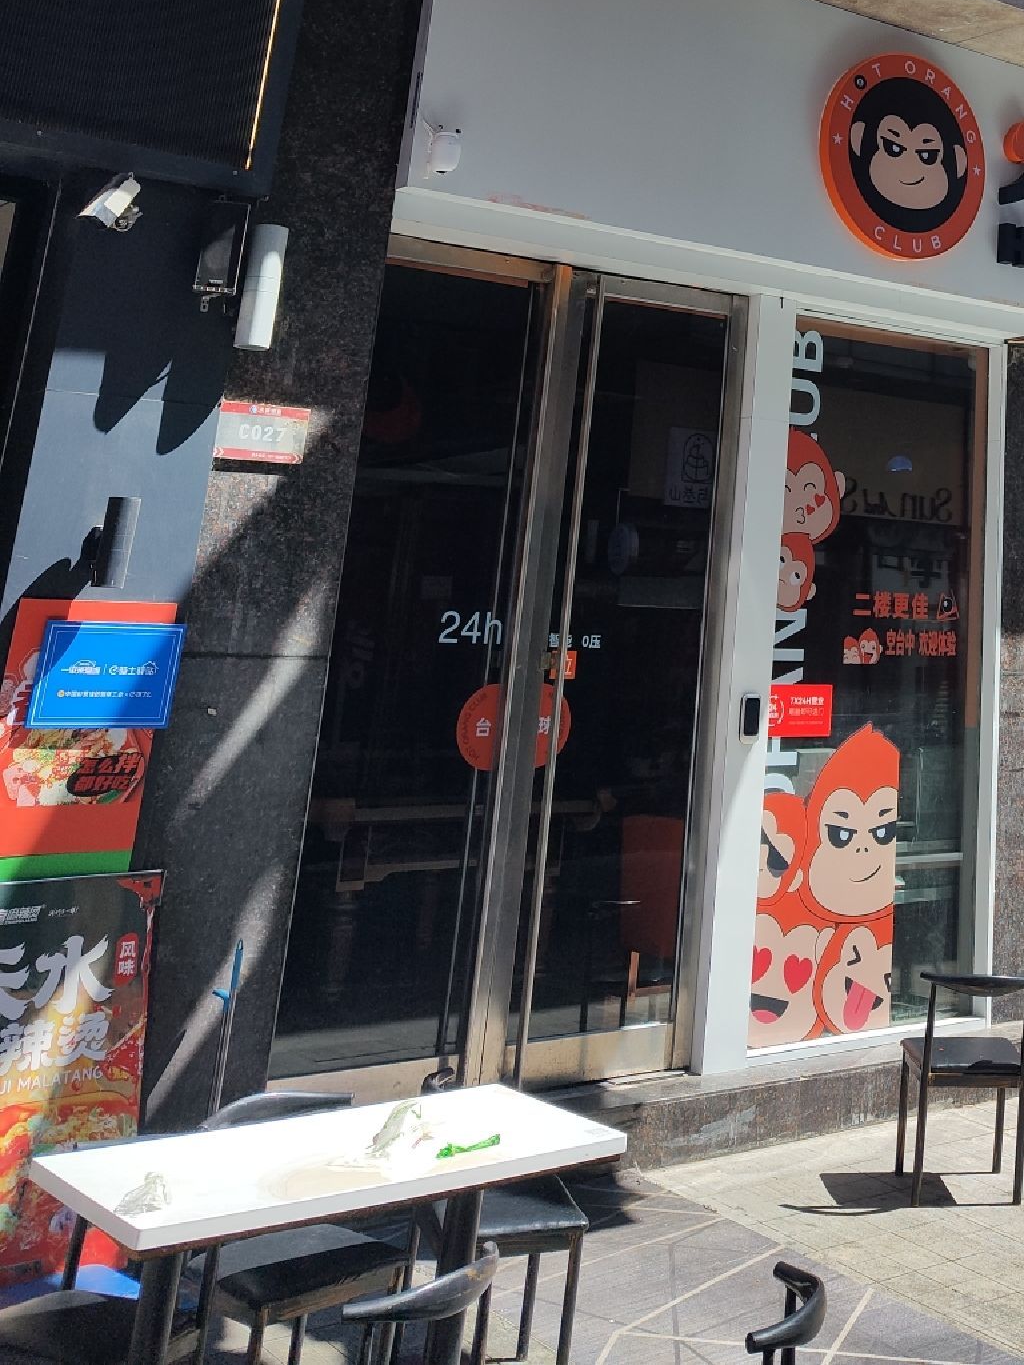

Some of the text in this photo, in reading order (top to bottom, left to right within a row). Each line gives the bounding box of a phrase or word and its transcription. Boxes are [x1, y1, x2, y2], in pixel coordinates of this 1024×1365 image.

[840, 60, 977, 144] HOT ORANG
[874, 226, 942, 253] CLUB
[238, 423, 287, 442] C027
[853, 591, 929, 620] 二楼更佳
[438, 611, 503, 645] 24h
[885, 629, 956, 657] 空台中 欢迎体验
[475, 718, 491, 737] 台
[117, 940, 138, 977] 风味
[18, 1066, 104, 1092] MALATANG
